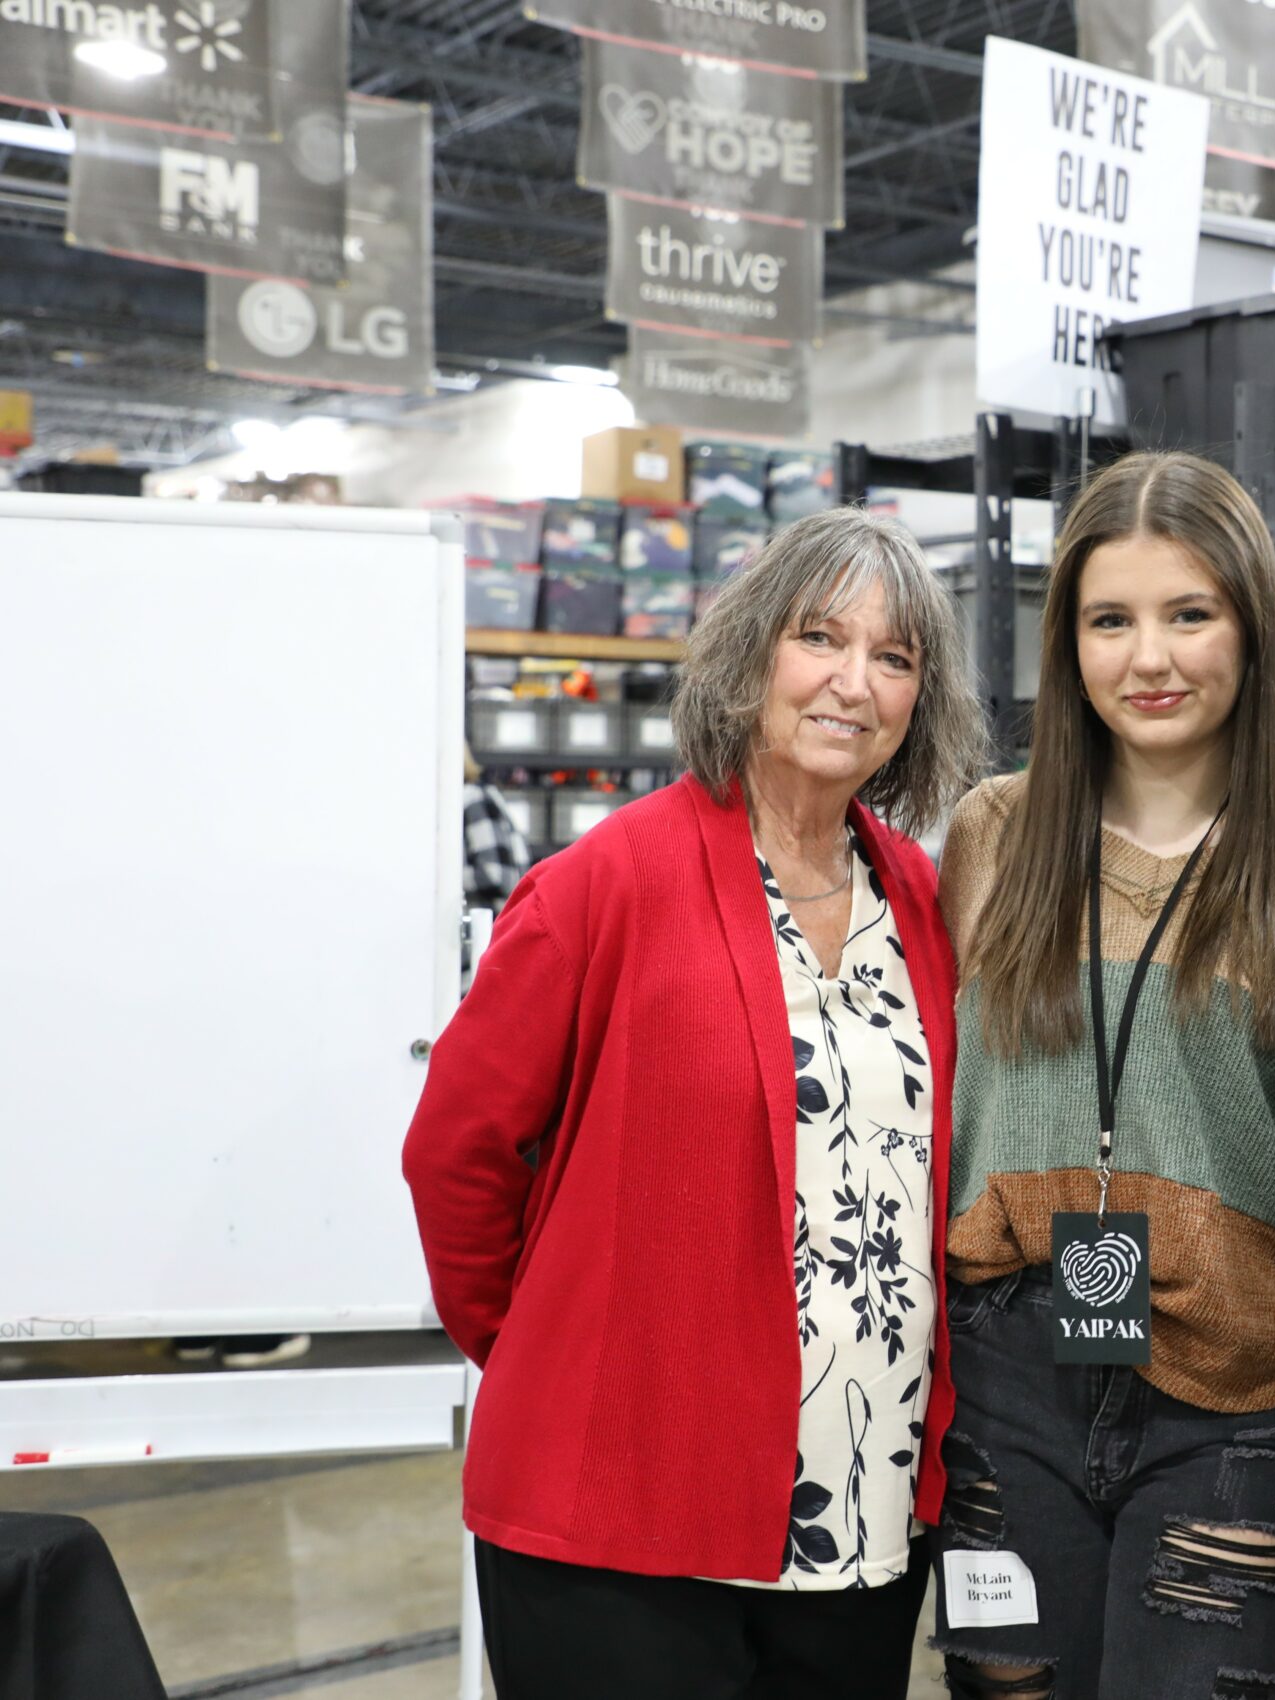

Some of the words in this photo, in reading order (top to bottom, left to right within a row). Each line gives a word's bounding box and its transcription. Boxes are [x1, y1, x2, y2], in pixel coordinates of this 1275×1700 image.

[1, 0, 167, 49] almart
[777, 5, 826, 32] PRO
[1049, 67, 1148, 153] WE'RE
[666, 122, 815, 185] HOPE
[160, 146, 260, 227] F&M
[1055, 150, 1130, 223] GLAD
[637, 225, 779, 293] thrive
[1039, 222, 1141, 304] YOU'RE
[325, 302, 410, 359] LG
[0, 1320, 34, 1339] NO
[1059, 1318, 1145, 1339] YAIPAK
[966, 1573, 1012, 1585] McLain
[968, 1589, 1013, 1604] Bryant
